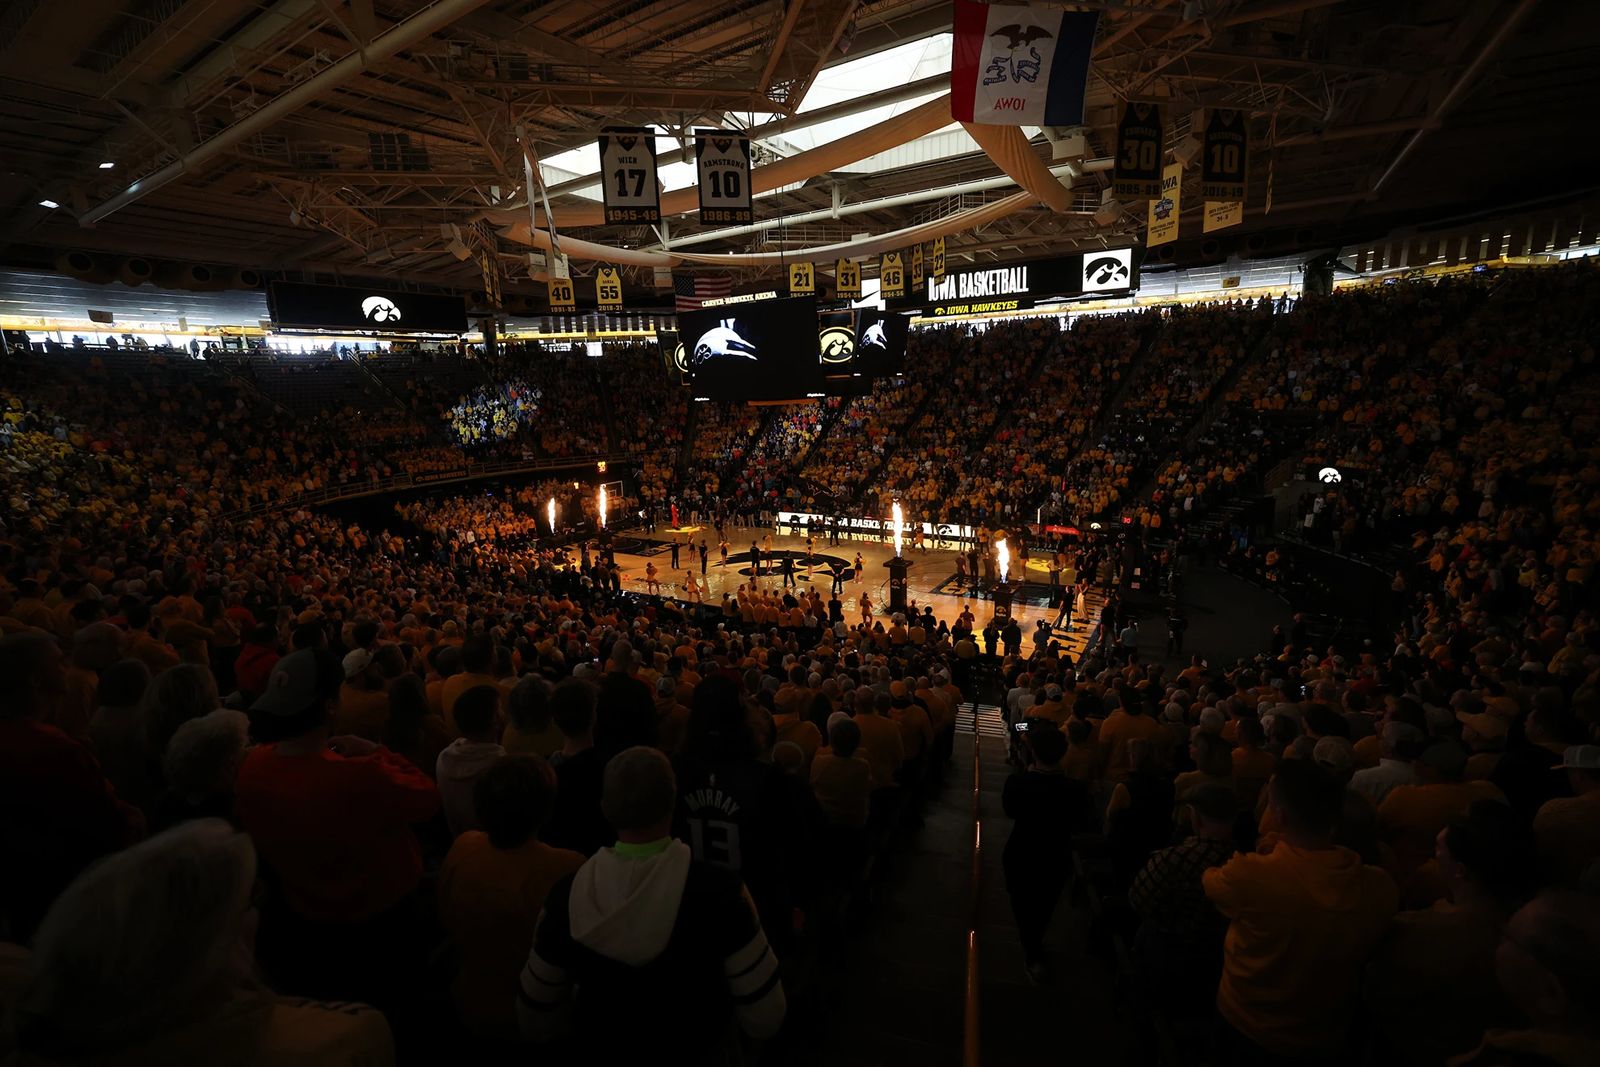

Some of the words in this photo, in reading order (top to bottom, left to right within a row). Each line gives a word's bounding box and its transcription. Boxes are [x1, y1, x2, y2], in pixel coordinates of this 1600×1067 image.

[1122, 139, 1157, 172] 30
[1211, 143, 1240, 174] 10
[703, 158, 745, 170] ARMSTRONG
[614, 168, 646, 197] 17
[708, 170, 740, 198] 10
[1163, 175, 1178, 190] WA
[608, 208, 659, 222] 1945-48
[703, 209, 751, 222] 1986-89
[934, 252, 944, 272] 22
[793, 271, 810, 287] 21
[841, 271, 857, 287] 31
[883, 270, 901, 287] 46
[928, 274, 956, 302] IOWA
[959, 265, 1030, 300] BASKETBALL
[552, 286, 571, 301] 40
[600, 285, 619, 300] 55
[946, 304, 970, 316] IOWA
[971, 300, 1020, 313] HAWKEYES
[850, 517, 912, 532] BASKETBLL
[684, 788, 741, 816] MURRAY
[685, 816, 742, 871] 13
